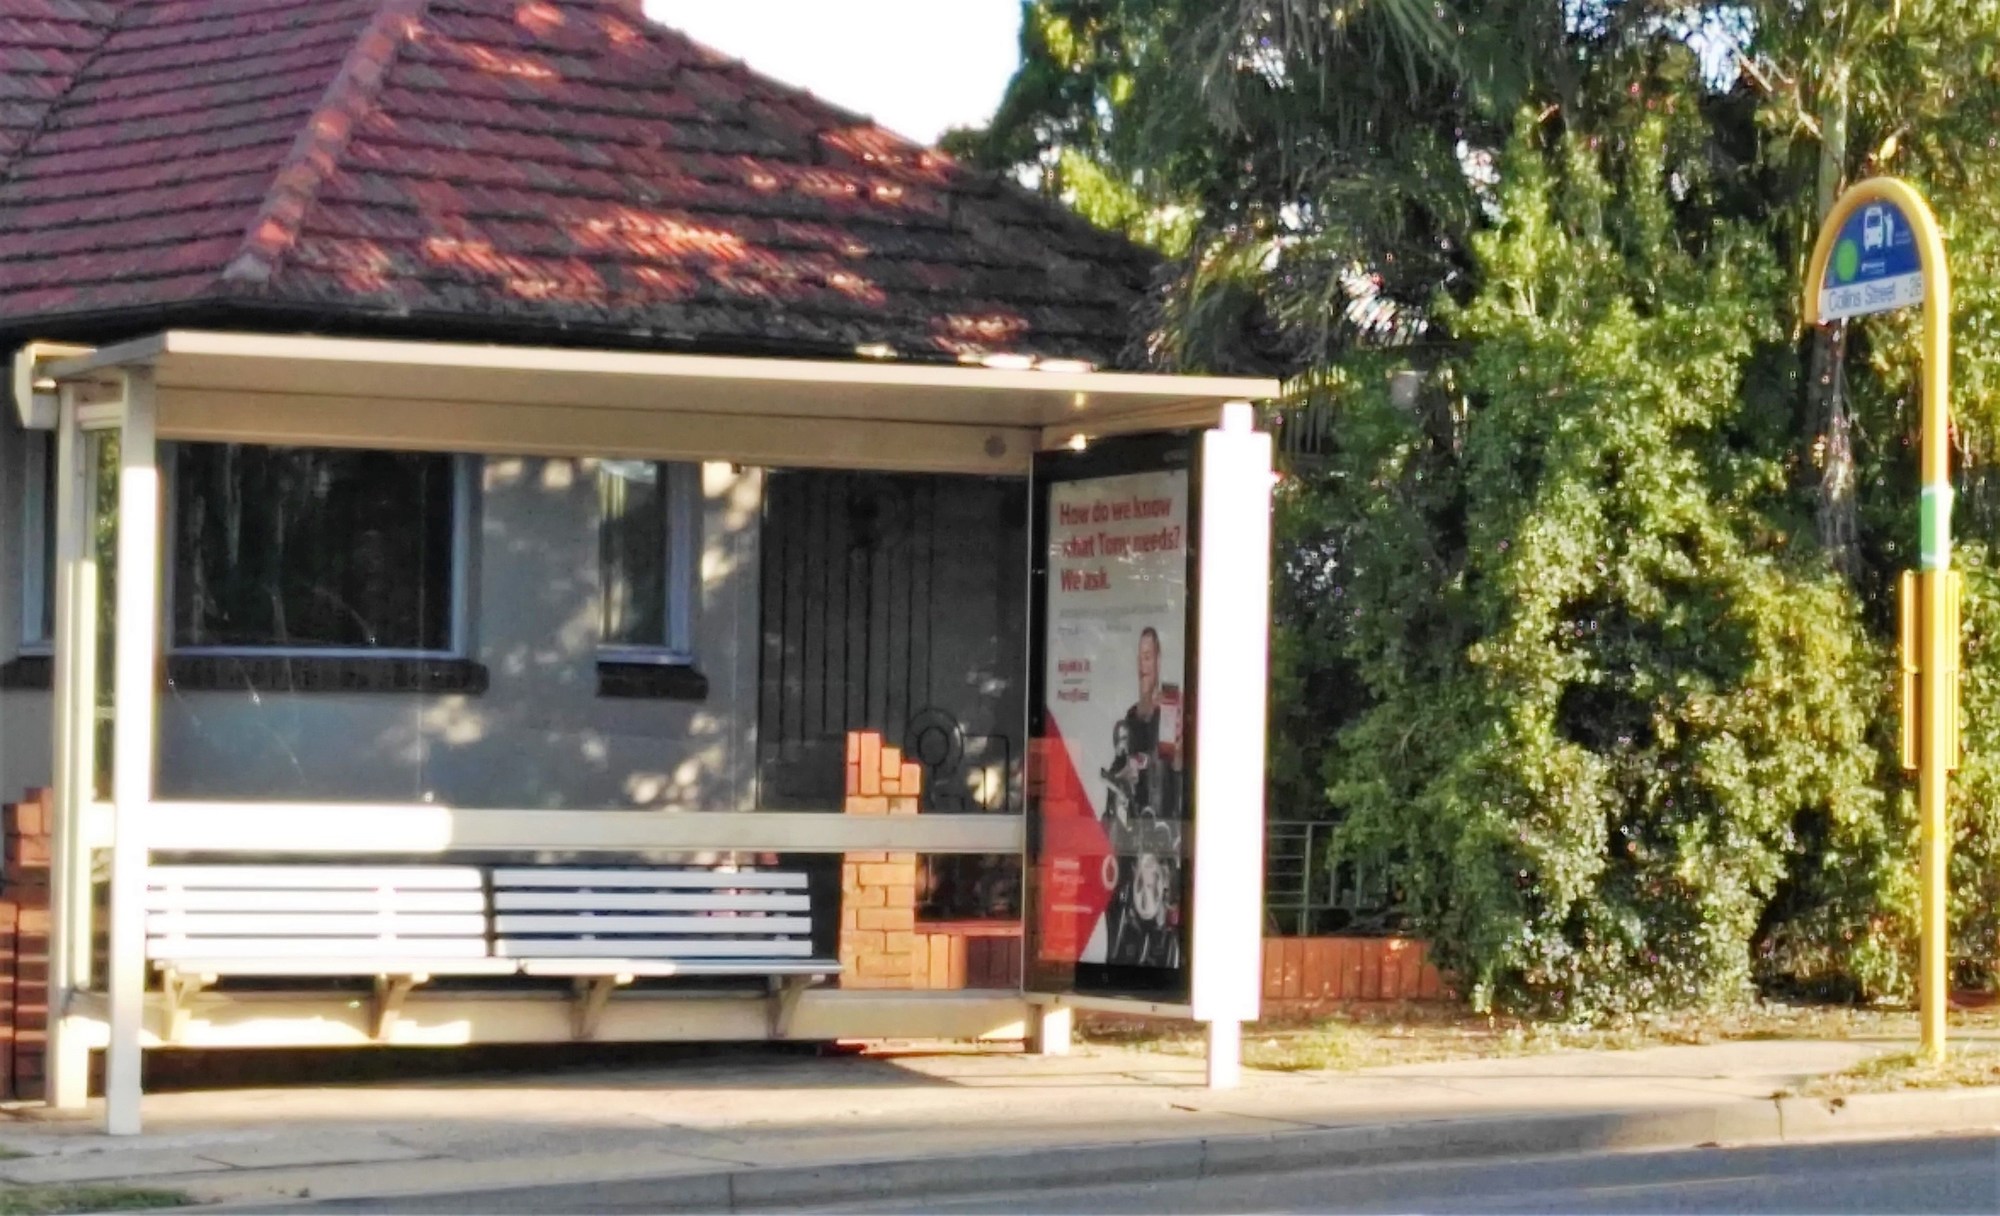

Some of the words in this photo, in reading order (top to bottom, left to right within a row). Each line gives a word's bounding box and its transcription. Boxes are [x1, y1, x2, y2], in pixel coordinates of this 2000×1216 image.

[1865, 282, 1896, 304] Street
[1060, 503, 1089, 526] How
[1092, 499, 1108, 522] do
[1112, 502, 1130, 521] we
[1133, 496, 1172, 518] know
[1133, 525, 1180, 552] needs?
[1060, 569, 1080, 592] We
[1084, 567, 1111, 591] ask.
